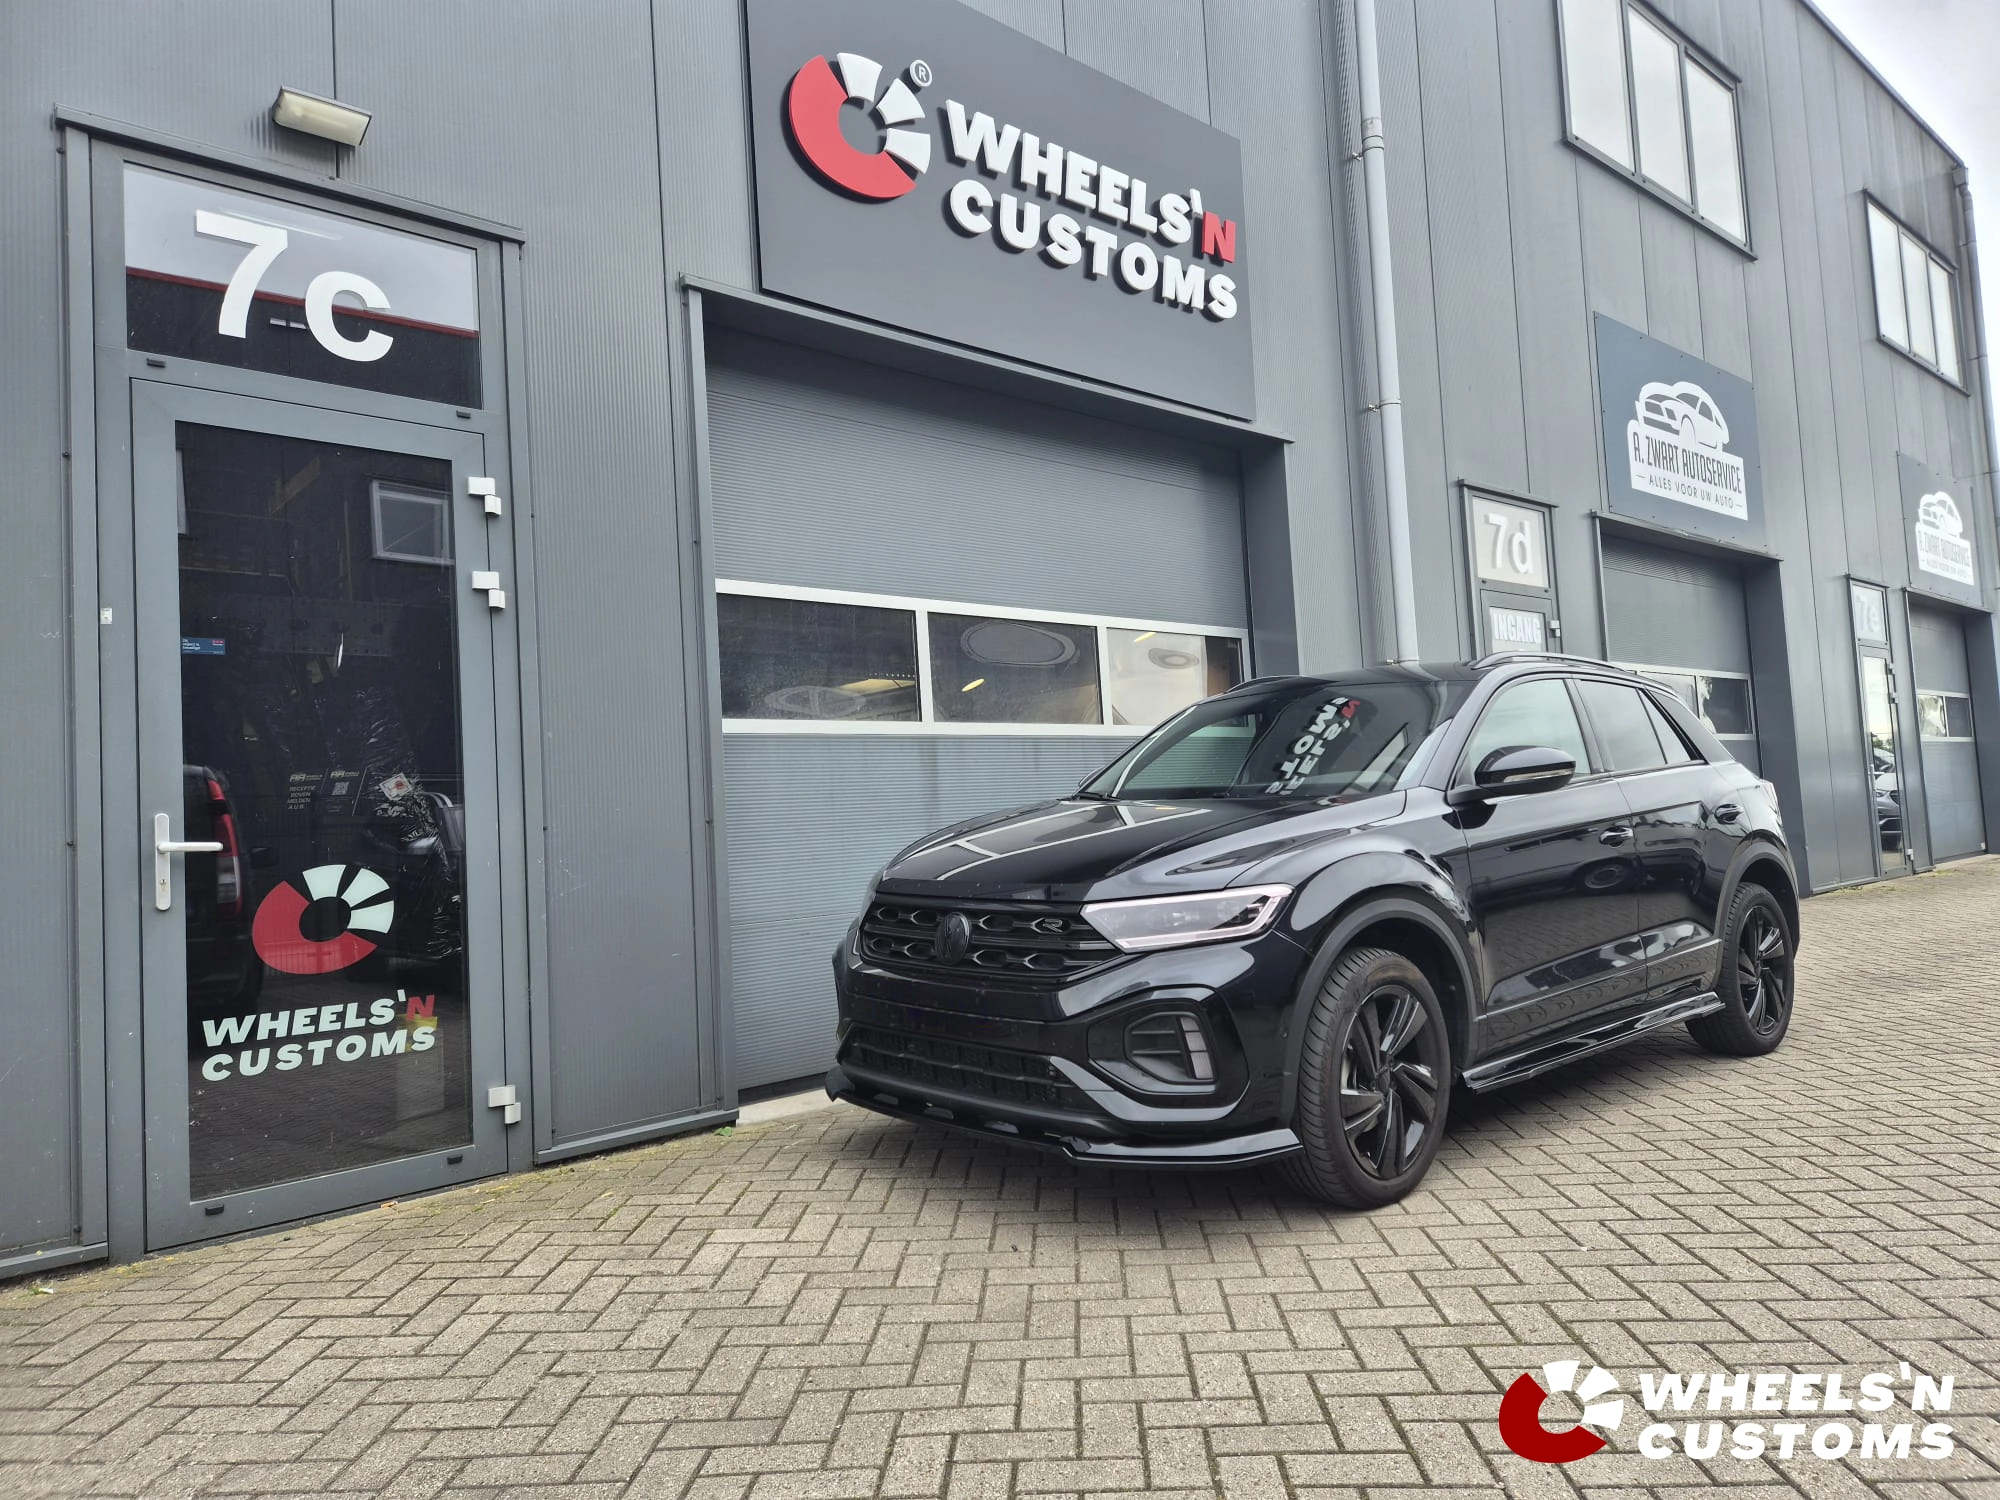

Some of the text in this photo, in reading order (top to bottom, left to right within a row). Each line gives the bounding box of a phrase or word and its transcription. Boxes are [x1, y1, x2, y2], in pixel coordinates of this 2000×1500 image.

[946, 99, 1237, 263] WHEELS'N
[949, 179, 1238, 319] CUSTOMS
[196, 209, 393, 362] 7c
[1633, 431, 1742, 494] A. ZWART AUTOSERVICE
[1649, 474, 1734, 509] ALLES VOOR UW AUTO
[1487, 512, 1533, 574] 7d
[1493, 612, 1542, 643] INGANG
[201, 989, 436, 1048] WHEELS'N
[201, 1026, 437, 1082] CUSTOMS
